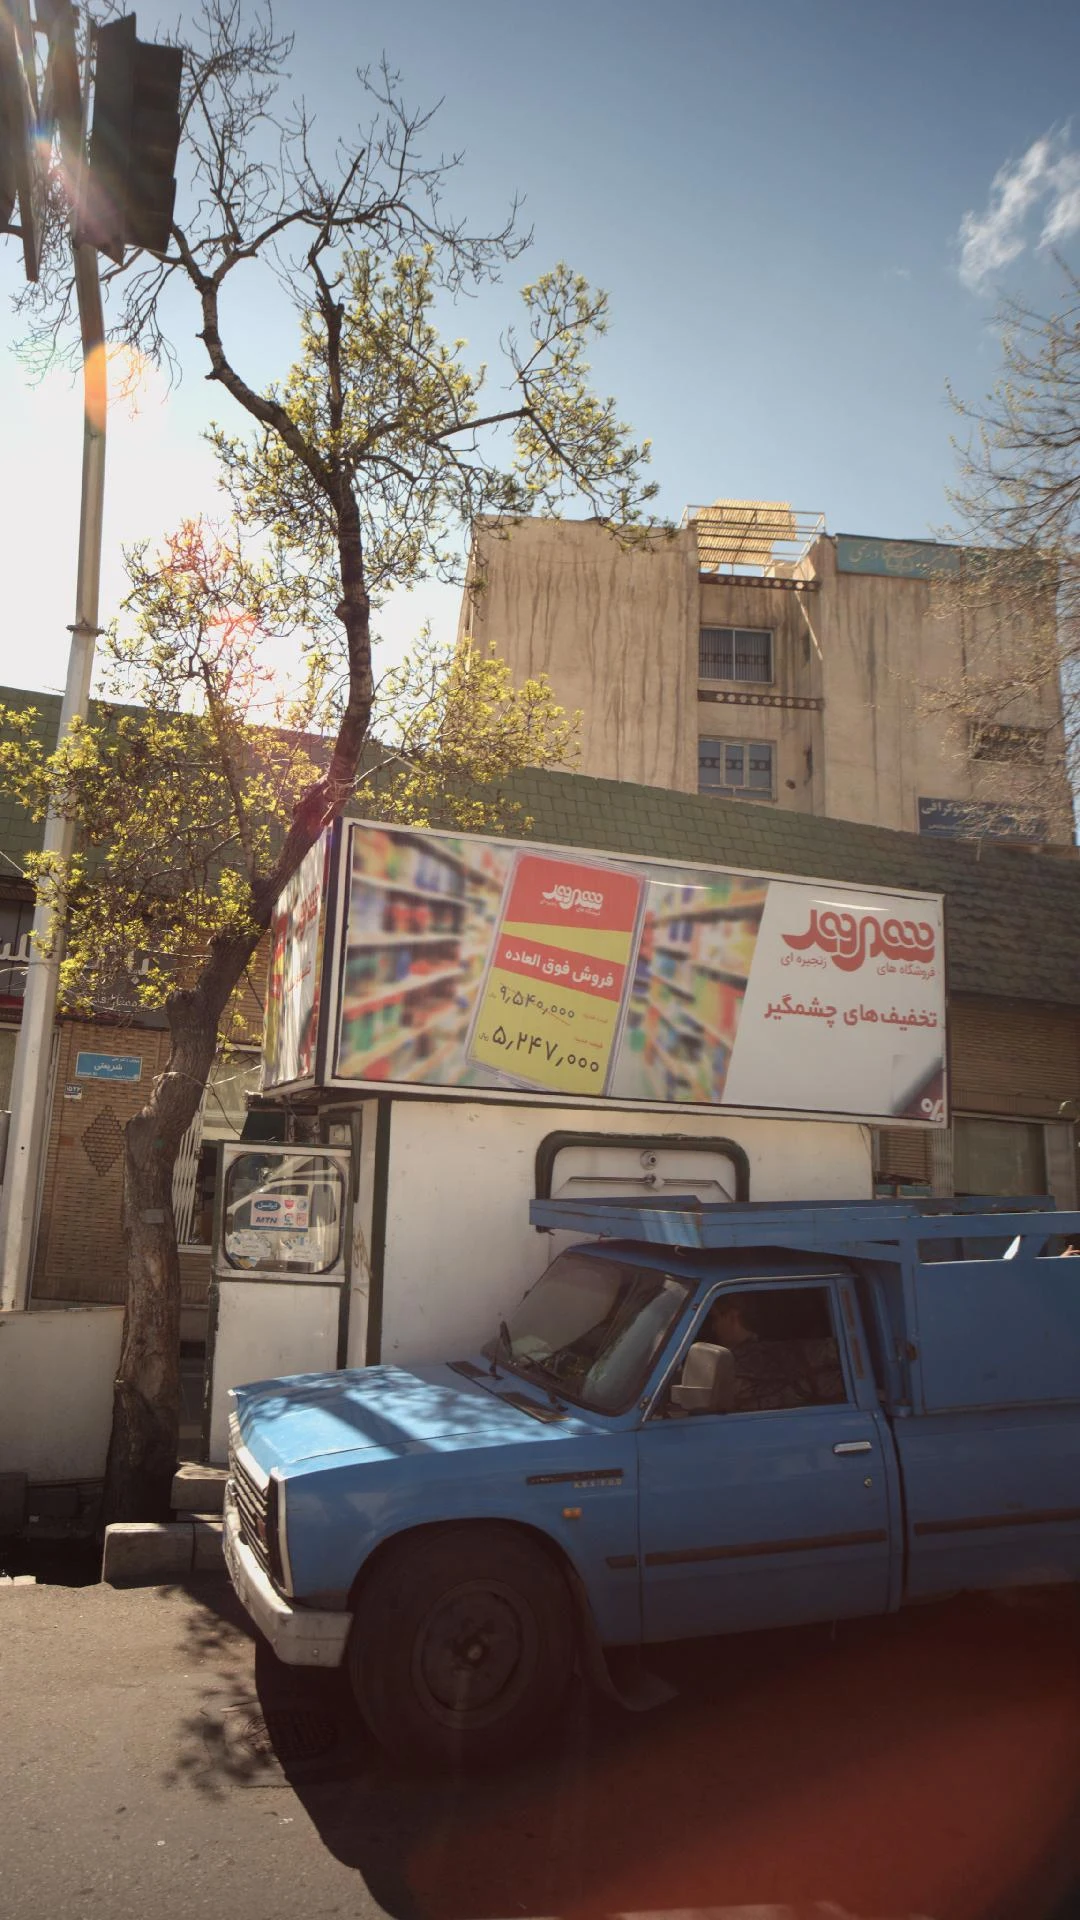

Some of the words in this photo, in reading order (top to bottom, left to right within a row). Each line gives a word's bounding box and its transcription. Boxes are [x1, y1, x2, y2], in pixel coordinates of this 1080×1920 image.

[505, 949, 541, 968] العاده
[795, 953, 828, 969] زنجیره
[542, 959, 570, 976] فوق
[899, 963, 936, 980] فروشگاه
[572, 968, 614, 989] فروش
[764, 993, 837, 1028] چشمگیر
[94, 1062, 123, 1072] شریعتی
[255, 1216, 278, 1224] MTN
